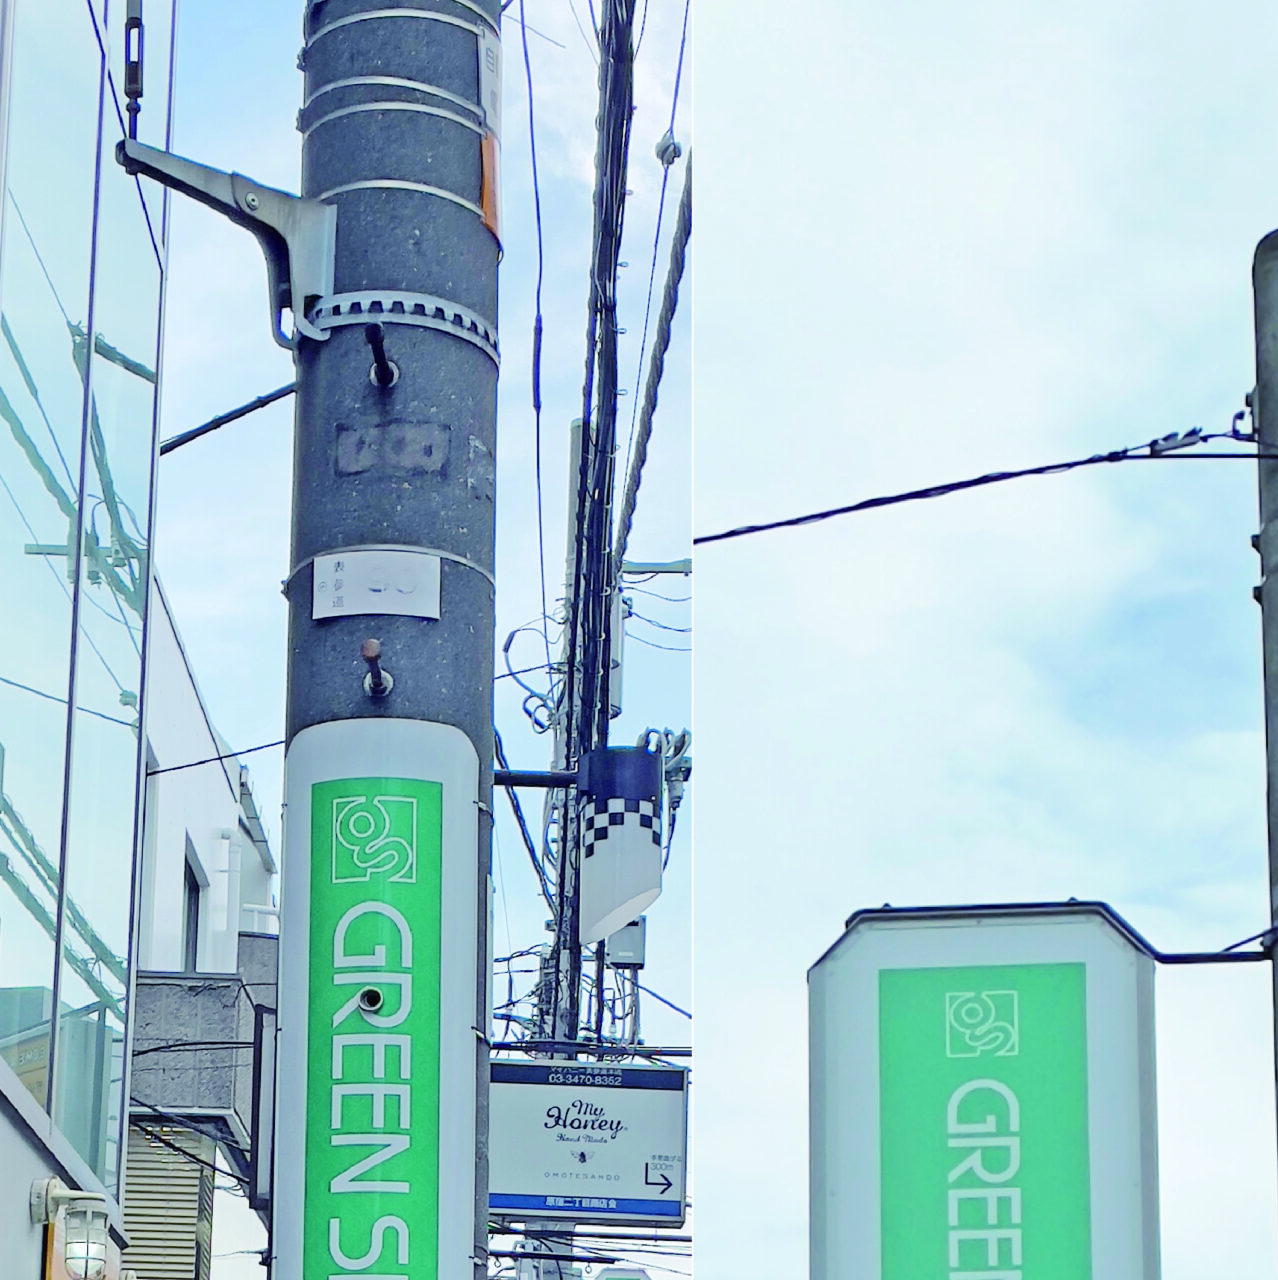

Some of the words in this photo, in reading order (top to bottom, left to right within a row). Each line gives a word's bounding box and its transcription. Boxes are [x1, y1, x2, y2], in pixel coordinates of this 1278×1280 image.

[330, 901, 413, 1193] GREEN
[543, 1105, 624, 1140] Honey
[571, 1099, 605, 1117] My
